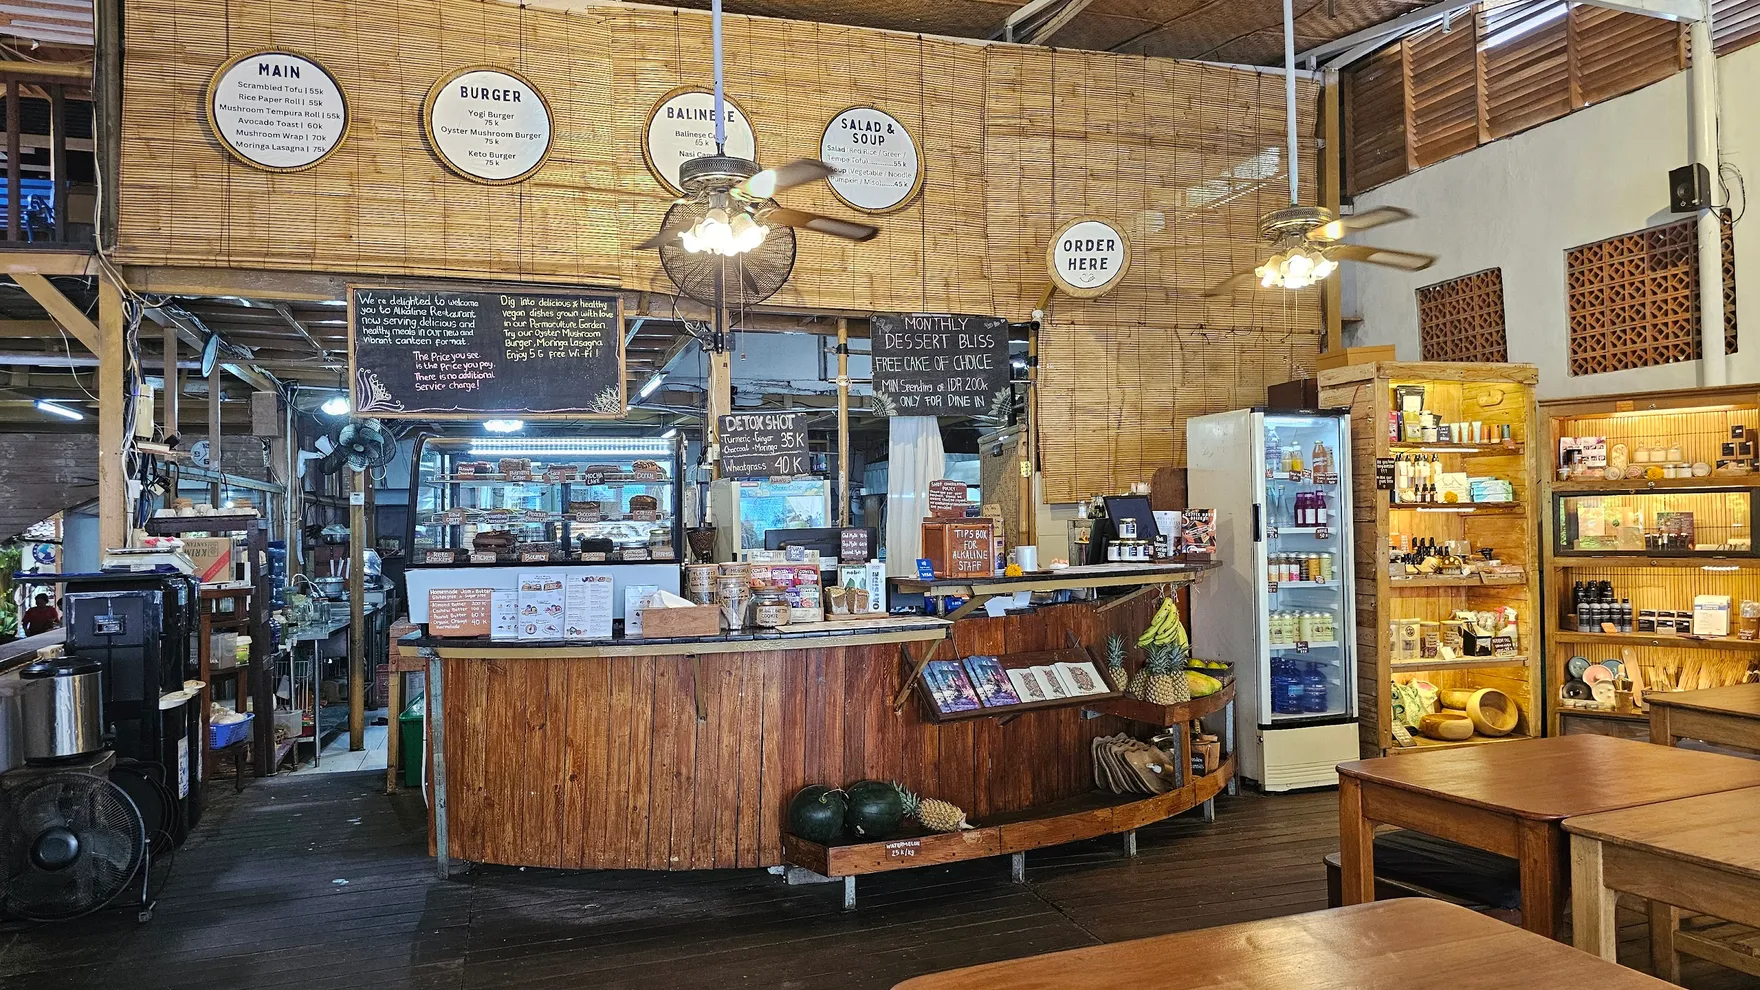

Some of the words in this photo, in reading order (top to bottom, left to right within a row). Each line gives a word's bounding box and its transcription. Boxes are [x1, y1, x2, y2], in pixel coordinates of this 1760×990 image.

[259, 63, 300, 79] MAIN
[238, 81, 282, 92] Scrambled
[258, 95, 282, 104] Paper
[285, 97, 300, 105] Roll
[460, 86, 521, 102] BURGER
[220, 104, 264, 114] Mushroom
[266, 108, 302, 117] Tempura
[305, 110, 320, 118] Roll
[468, 110, 486, 119] Yogi
[488, 111, 514, 120] Burger
[667, 107, 734, 122] BALINEE
[238, 118, 274, 126] Avocado
[841, 118, 881, 132] SALAD
[887, 123, 895, 134] &
[236, 130, 280, 139] Mushroom
[441, 126, 468, 135] Oyster
[470, 129, 513, 138] Mushroom
[853, 133, 885, 146] SOUP
[235, 141, 270, 150] Moringa
[272, 144, 304, 152] Lasagna
[1064, 239, 1115, 252] ORDER
[1068, 258, 1108, 270] HERE
[390, 295, 431, 309] delighted
[435, 296, 445, 305] to
[448, 298, 479, 307] welcome
[500, 295, 515, 308] Dig
[539, 298, 571, 307] delicious
[580, 298, 607, 310] healthy
[360, 307, 376, 315] you
[379, 305, 390, 314] to
[393, 307, 427, 315] Alkaline
[430, 306, 476, 318] Restaurant
[502, 310, 525, 320] vegan
[530, 309, 554, 317] dishes
[556, 310, 578, 319] grown
[599, 310, 613, 318] love
[383, 318, 416, 328] serving
[420, 317, 456, 328] delicious
[459, 320, 475, 328] and
[529, 319, 577, 329] Permaculture
[905, 318, 968, 330] MONTHLY
[363, 326, 390, 337] healthy
[392, 328, 415, 336] meals
[418, 327, 425, 336] in
[503, 329, 515, 339] Try
[535, 330, 560, 338] Oyster
[562, 329, 600, 337] Mushroom
[537, 338, 568, 349] Moringa
[570, 340, 602, 350] Lasagna
[885, 334, 950, 349] DESSERT
[959, 334, 995, 348] BLISS
[413, 351, 429, 361] The
[431, 352, 450, 361] Price
[451, 352, 465, 363] you
[507, 350, 527, 361] Enjoy
[462, 362, 478, 372] you
[875, 357, 901, 372] FREE
[904, 356, 931, 371] CAKE
[934, 356, 948, 371] OF
[954, 354, 993, 371] CHOICE
[458, 371, 495, 379] additional
[449, 380, 479, 392] charge!
[882, 379, 898, 392] MIN
[901, 380, 932, 393] Spending
[947, 378, 961, 392] IDR
[900, 395, 919, 407] ONLY
[924, 396, 942, 406] FOR
[948, 394, 970, 407] DINE
[974, 396, 985, 407] IN
[726, 415, 764, 431] DETOX
[766, 414, 795, 430] SHOT
[723, 459, 766, 475] Wheatgrass
[775, 456, 789, 474] 40
[954, 530, 974, 538] TIPS
[975, 530, 987, 539] BOX
[964, 541, 977, 549] FOR
[953, 551, 988, 560] ALKALINE
[959, 561, 981, 571] STAFF
